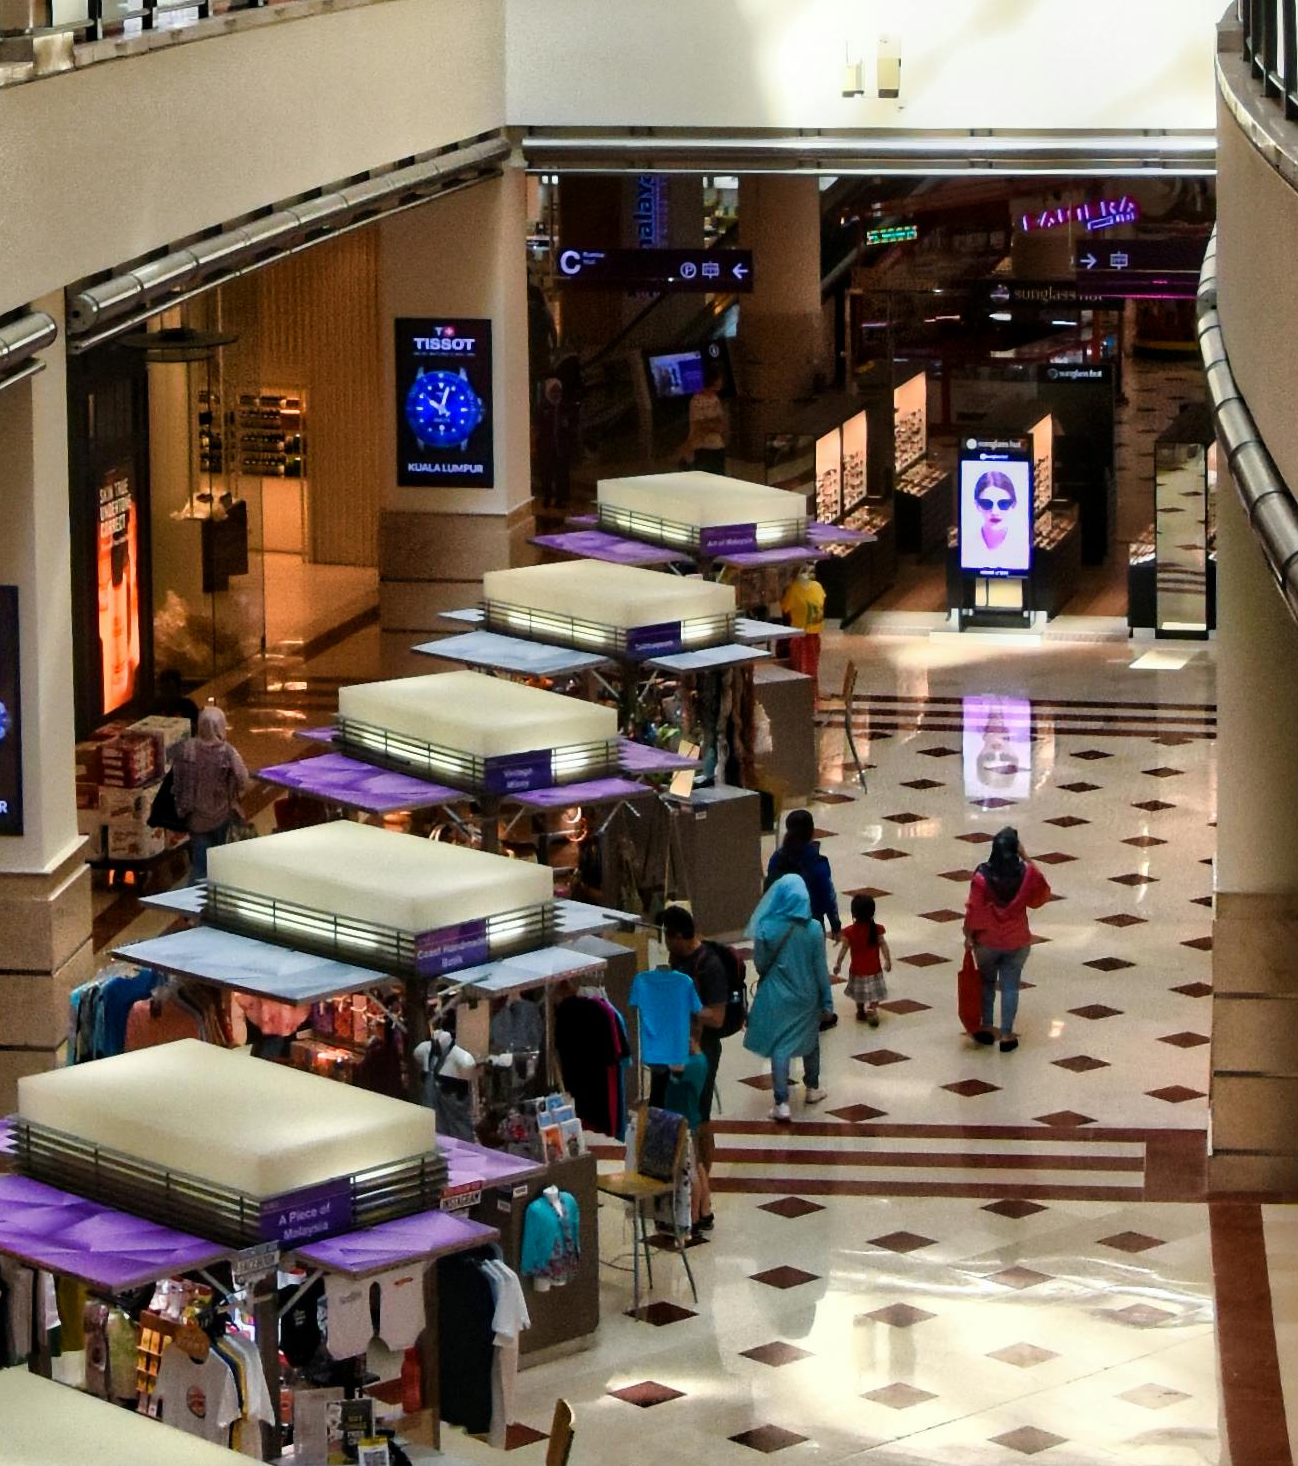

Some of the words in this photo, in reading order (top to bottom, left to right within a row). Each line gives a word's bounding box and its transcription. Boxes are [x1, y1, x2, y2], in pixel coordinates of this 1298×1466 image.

[560, 250, 582, 275] C
[1014, 286, 1076, 301] sunglass
[413, 337, 475, 350] TISSOT
[407, 462, 441, 473] KUALA
[442, 464, 484, 474] LUMPUR
